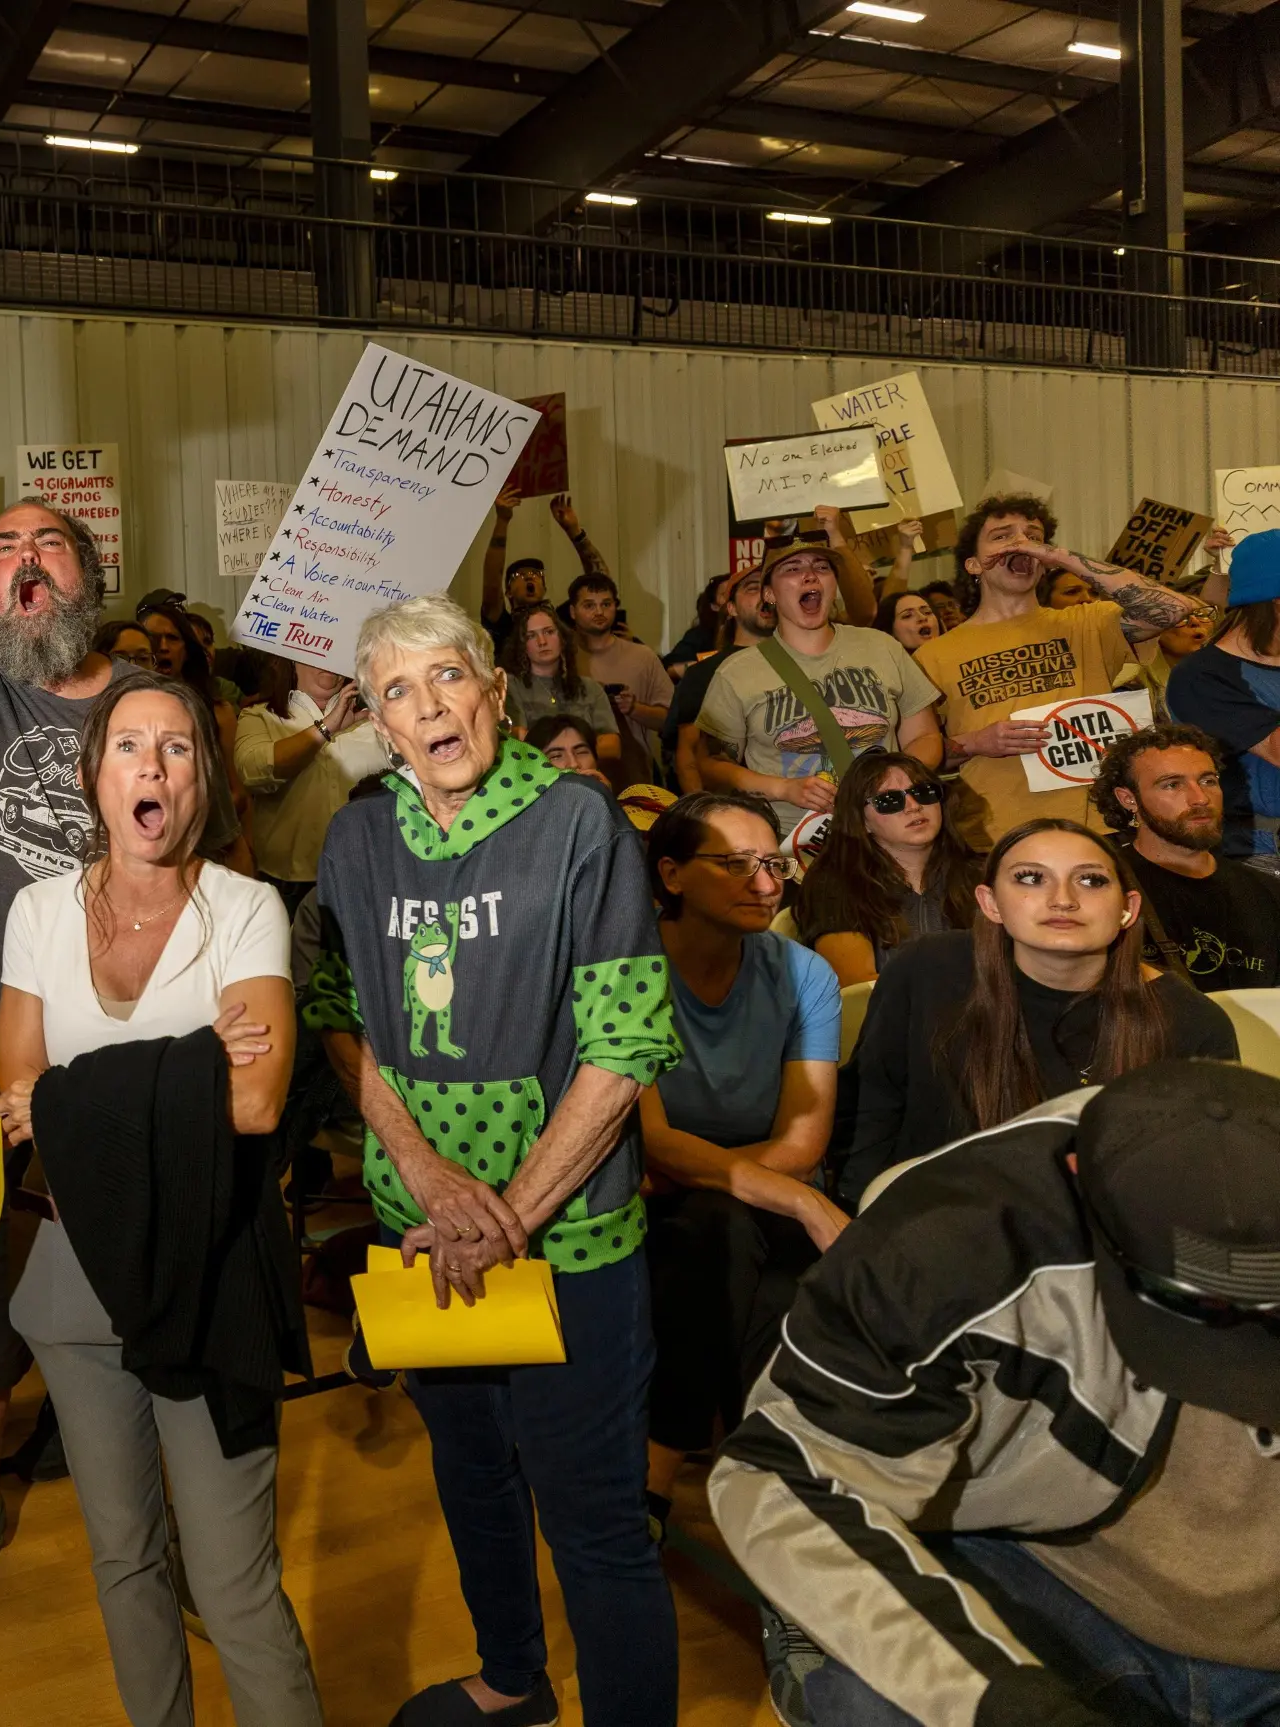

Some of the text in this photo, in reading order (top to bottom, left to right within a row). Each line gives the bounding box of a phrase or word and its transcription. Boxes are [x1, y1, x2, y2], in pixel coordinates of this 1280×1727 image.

[370, 355, 529, 455] UTAHANS
[831, 382, 908, 421] WATER
[27, 450, 103, 470] WE GET
[336, 402, 490, 487] DEMAND
[739, 448, 770, 469] No
[810, 442, 857, 456] Elected
[47, 476, 114, 491] GIGAWATTS
[333, 448, 437, 501] Transparency
[61, 492, 102, 504] SMOG
[217, 483, 261, 507] WHERE
[318, 479, 392, 521] Honesty
[73, 507, 120, 519] LAKEBED
[1140, 501, 1196, 528] TURN
[219, 527, 260, 547] WHERE
[301, 506, 396, 552] Accountability
[1127, 515, 1178, 543] OFF
[293, 527, 380, 574] Responsibility
[1125, 535, 1168, 563] THE
[278, 554, 295, 575] A
[304, 561, 339, 586] Voice
[268, 578, 329, 604] Clean Air
[260, 595, 339, 624] Clean Water
[249, 611, 334, 651] THE TRUTH
[960, 640, 1064, 677] MISSOURI
[961, 654, 1073, 694] EXECUTIVE
[975, 673, 1073, 706] ORDER 44
[1054, 711, 1114, 742] DATA
